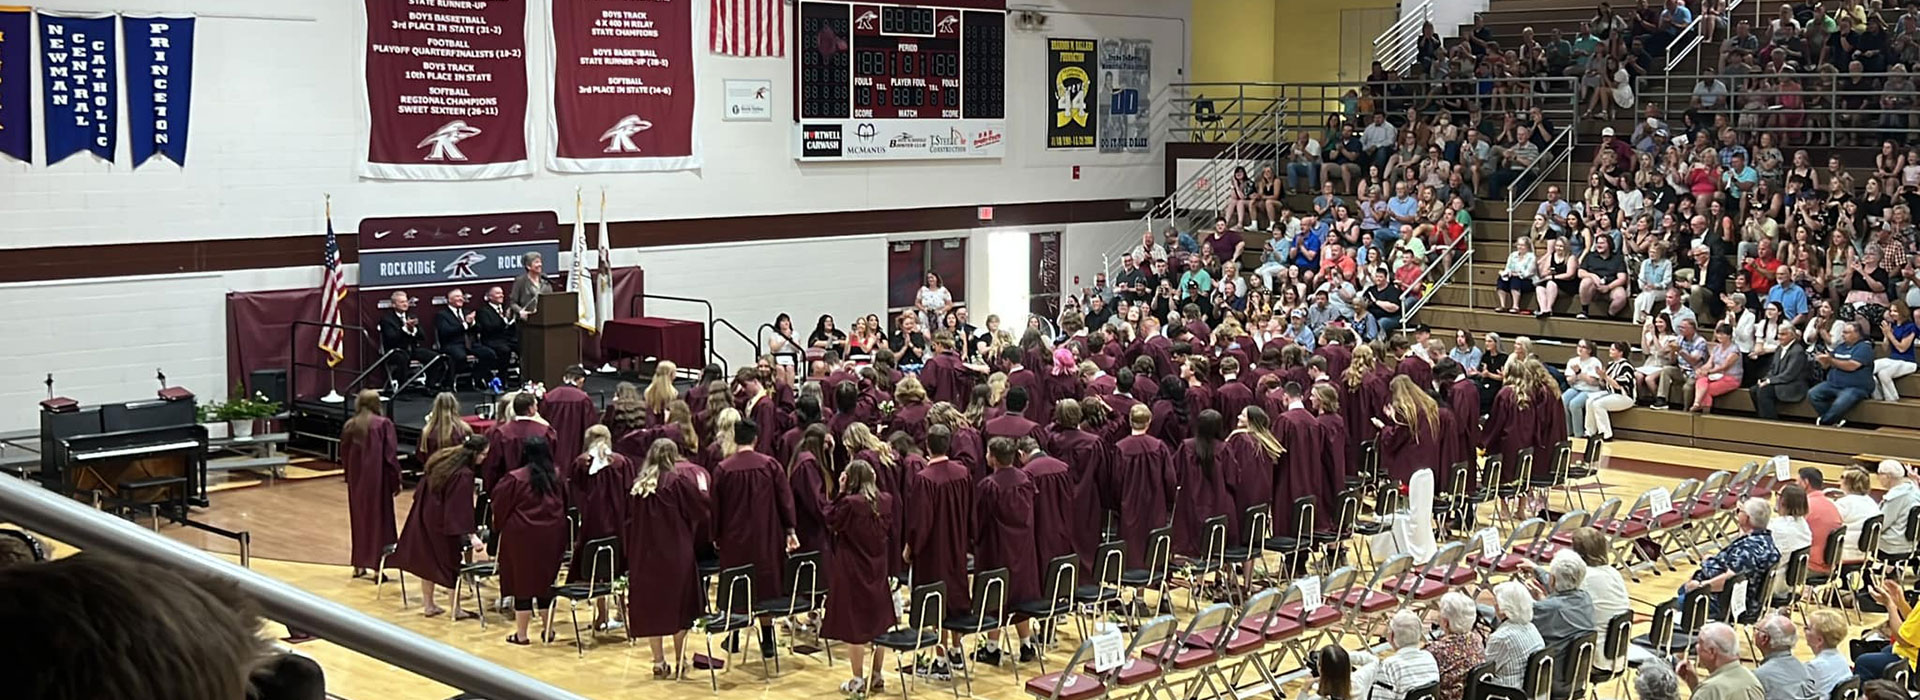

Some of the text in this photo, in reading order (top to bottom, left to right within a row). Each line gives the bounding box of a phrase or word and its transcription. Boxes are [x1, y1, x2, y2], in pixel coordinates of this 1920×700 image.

[437, 1, 487, 9] RUNNER-UP
[409, 12, 487, 24] BOYS BASKETBALL
[392, 21, 407, 29] 3rd
[408, 22, 435, 30] PLACE
[450, 25, 475, 33] STATE
[631, 20, 654, 28] RELAY
[592, 28, 659, 37] STATE CHAMPIONS
[427, 38, 470, 48] FOOTBALL
[373, 44, 410, 54] PLAYOFF
[412, 46, 494, 58] QUARTERFINALISTS
[898, 44, 918, 52] PERIOD
[614, 49, 657, 57] BASKETBALL
[48, 24, 68, 105] NEWMAN
[580, 57, 603, 65] STATE
[604, 58, 646, 66] RUNNER-UP
[423, 62, 475, 72] BOYS TRACK
[71, 33, 90, 126] CENTRAL
[405, 71, 492, 81] 10th PLACE IN STATE
[150, 23, 170, 144] PRINCETON
[608, 77, 643, 85] SOFTBALL
[855, 77, 872, 86] FOULS
[891, 78, 926, 87] PLAYER FOUL
[942, 79, 959, 87] FOULS
[91, 40, 108, 147] CATHOLIC
[429, 87, 470, 96] SOFTBALL
[592, 86, 615, 94] PLACE
[616, 86, 625, 94] IN
[626, 86, 648, 94] STATE
[400, 96, 497, 106] REGIONAL CHAMPIONS
[398, 105, 428, 114] SWEET
[430, 106, 466, 115] SIXTEEN
[855, 109, 873, 117] SCORE
[942, 110, 959, 118] SCORE
[806, 141, 839, 149] CARWASH
[380, 260, 436, 276] ROCKRIDGE
